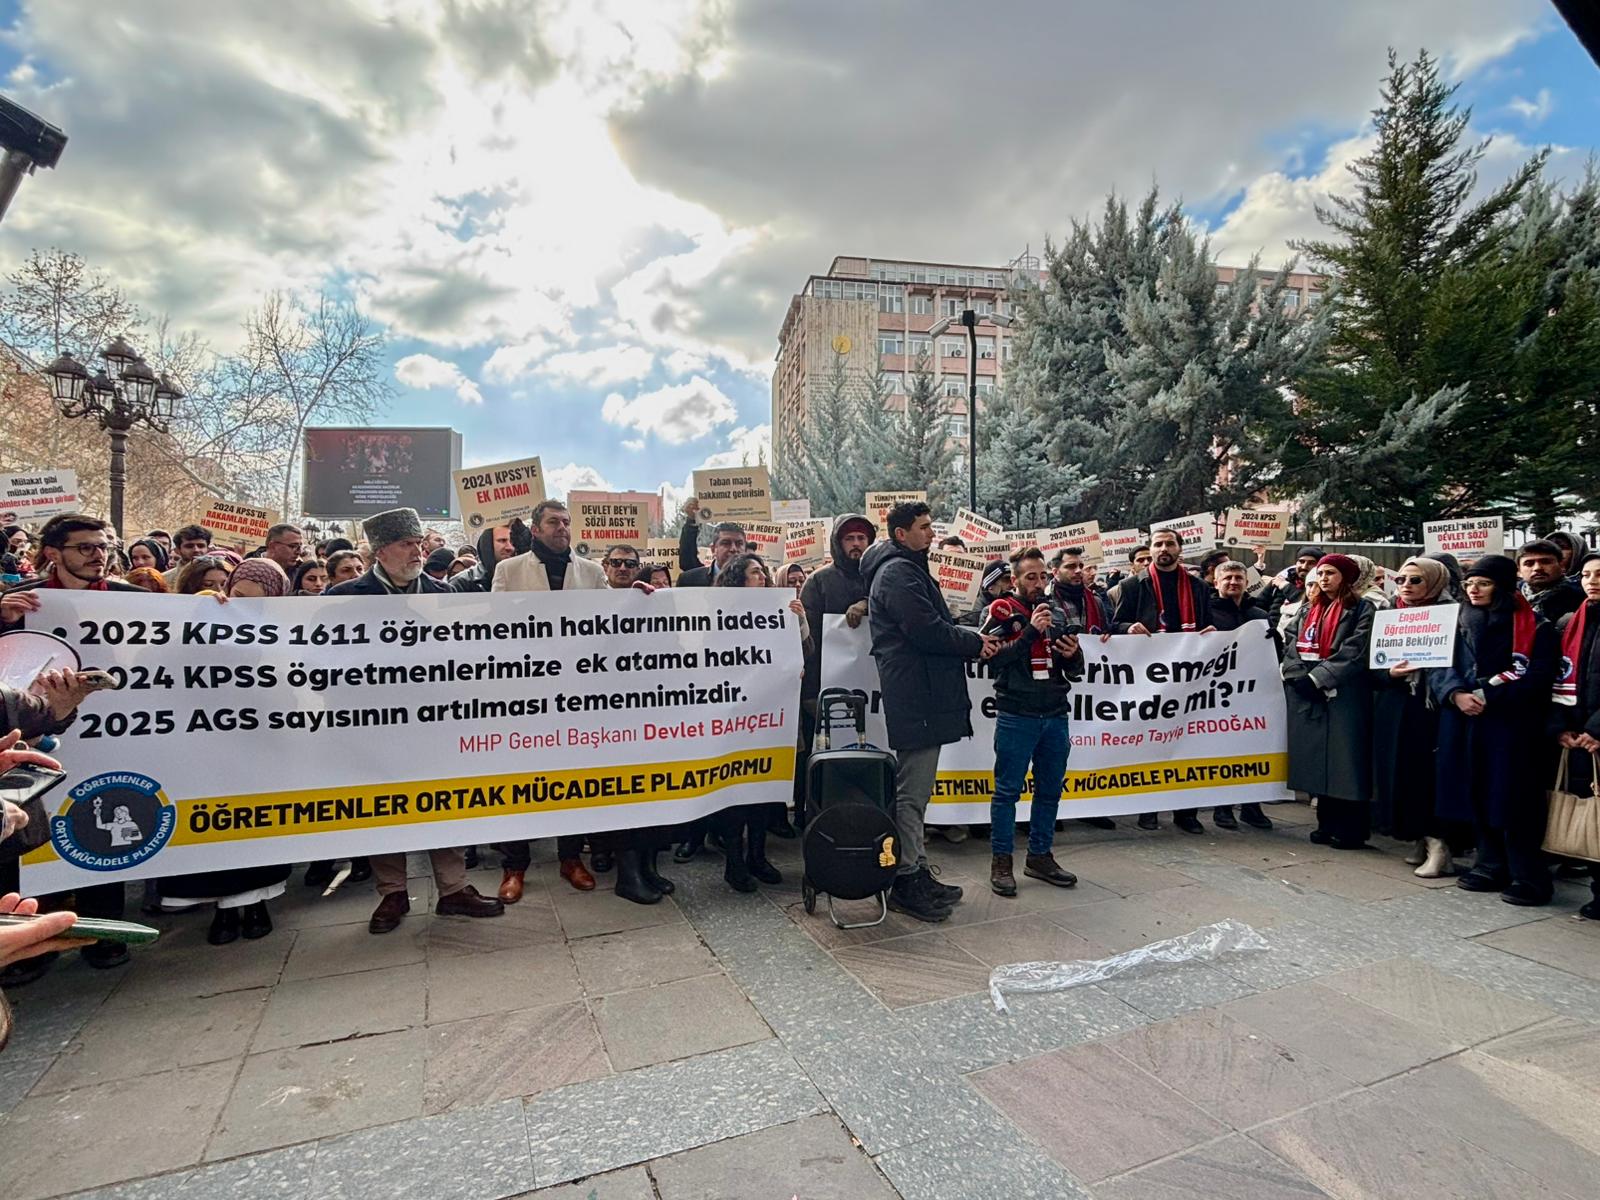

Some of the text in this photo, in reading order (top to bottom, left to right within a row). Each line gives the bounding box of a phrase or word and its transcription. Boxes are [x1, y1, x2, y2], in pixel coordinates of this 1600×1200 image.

[462, 465, 537, 490] 2024 KPSS'YE
[709, 476, 752, 487] Taban maaş
[7, 487, 38, 497] mülakat
[476, 482, 530, 504] EK ATAMA
[699, 488, 765, 500] hakkımız getirilsin
[214, 502, 234, 512] 2024
[582, 505, 611, 515] DEVLET
[206, 511, 269, 529] RAKAMLAR DEĞİL
[585, 517, 606, 527] SÖZÜ
[1478, 519, 1498, 528] SÖZÜ
[200, 519, 268, 537] HAYATLAR KÜÇÜLD
[581, 530, 639, 539] EK KONTENJAN
[756, 524, 782, 534] HEDEFSE
[1050, 527, 1086, 541] 2024 KPSS
[745, 533, 778, 544] ONTENJAN
[1438, 530, 1488, 541] DEVLET SÖZÜ
[658, 548, 680, 556] varsa
[1442, 541, 1485, 550] OLMALIYDI
[953, 557, 985, 571] KONTENJAN
[938, 564, 974, 581] ÖĞRETMENE
[1399, 610, 1430, 623] Engelli
[79, 609, 785, 647] 2023 KPSS 1611 öğretmenin haklarınının iadesi
[1376, 635, 1448, 648] Atama Bekliyor!
[184, 665, 278, 689] KPSS
[576, 653, 608, 674] ek
[615, 650, 699, 672] atama
[704, 646, 772, 668] hakkı
[1146, 641, 1238, 683] emeği
[79, 682, 748, 738] 2025 AGS sayısının artılması temennimizdir.
[1066, 694, 1180, 721] llerde
[460, 708, 784, 753] MHP Genel Başkanı Devlet BAHÇELİ
[1101, 732, 1144, 746] Recep
[1148, 725, 1184, 744] Tayyip
[1187, 714, 1266, 735] ERDOĞAN
[931, 779, 994, 796] ETMENL
[1073, 769, 1162, 792] MÜCADELE
[1164, 761, 1270, 784] PLATFORMU
[75, 775, 153, 797] ÖĞRETMENLER
[189, 756, 772, 834] ÖĞRETMENLER ORTAK MÜCADELE PLATFORMU
[55, 811, 172, 866] ORTAK MÜCADELE PLATFORMU
